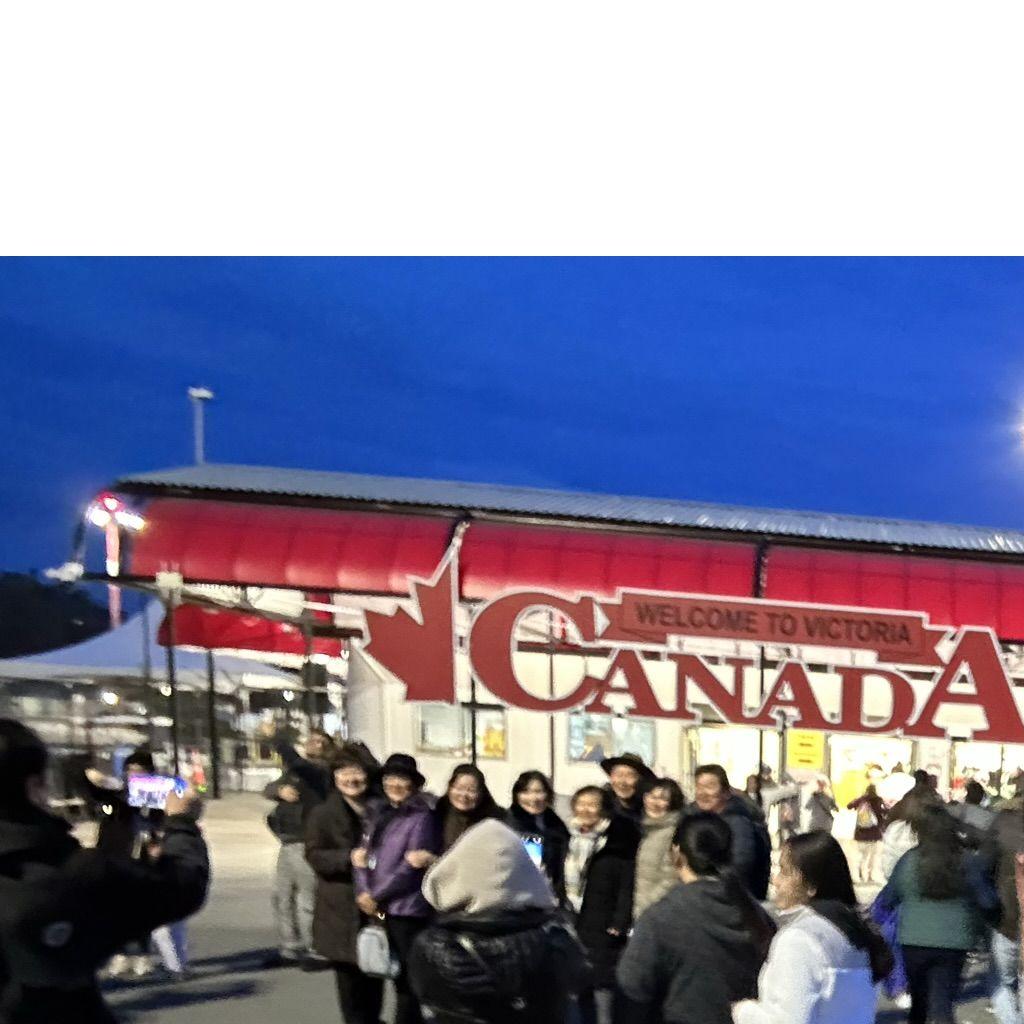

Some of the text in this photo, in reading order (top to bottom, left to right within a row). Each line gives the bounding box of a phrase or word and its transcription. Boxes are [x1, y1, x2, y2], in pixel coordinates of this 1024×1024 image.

[634, 602, 912, 645] WELCOME TO VICTORIA
